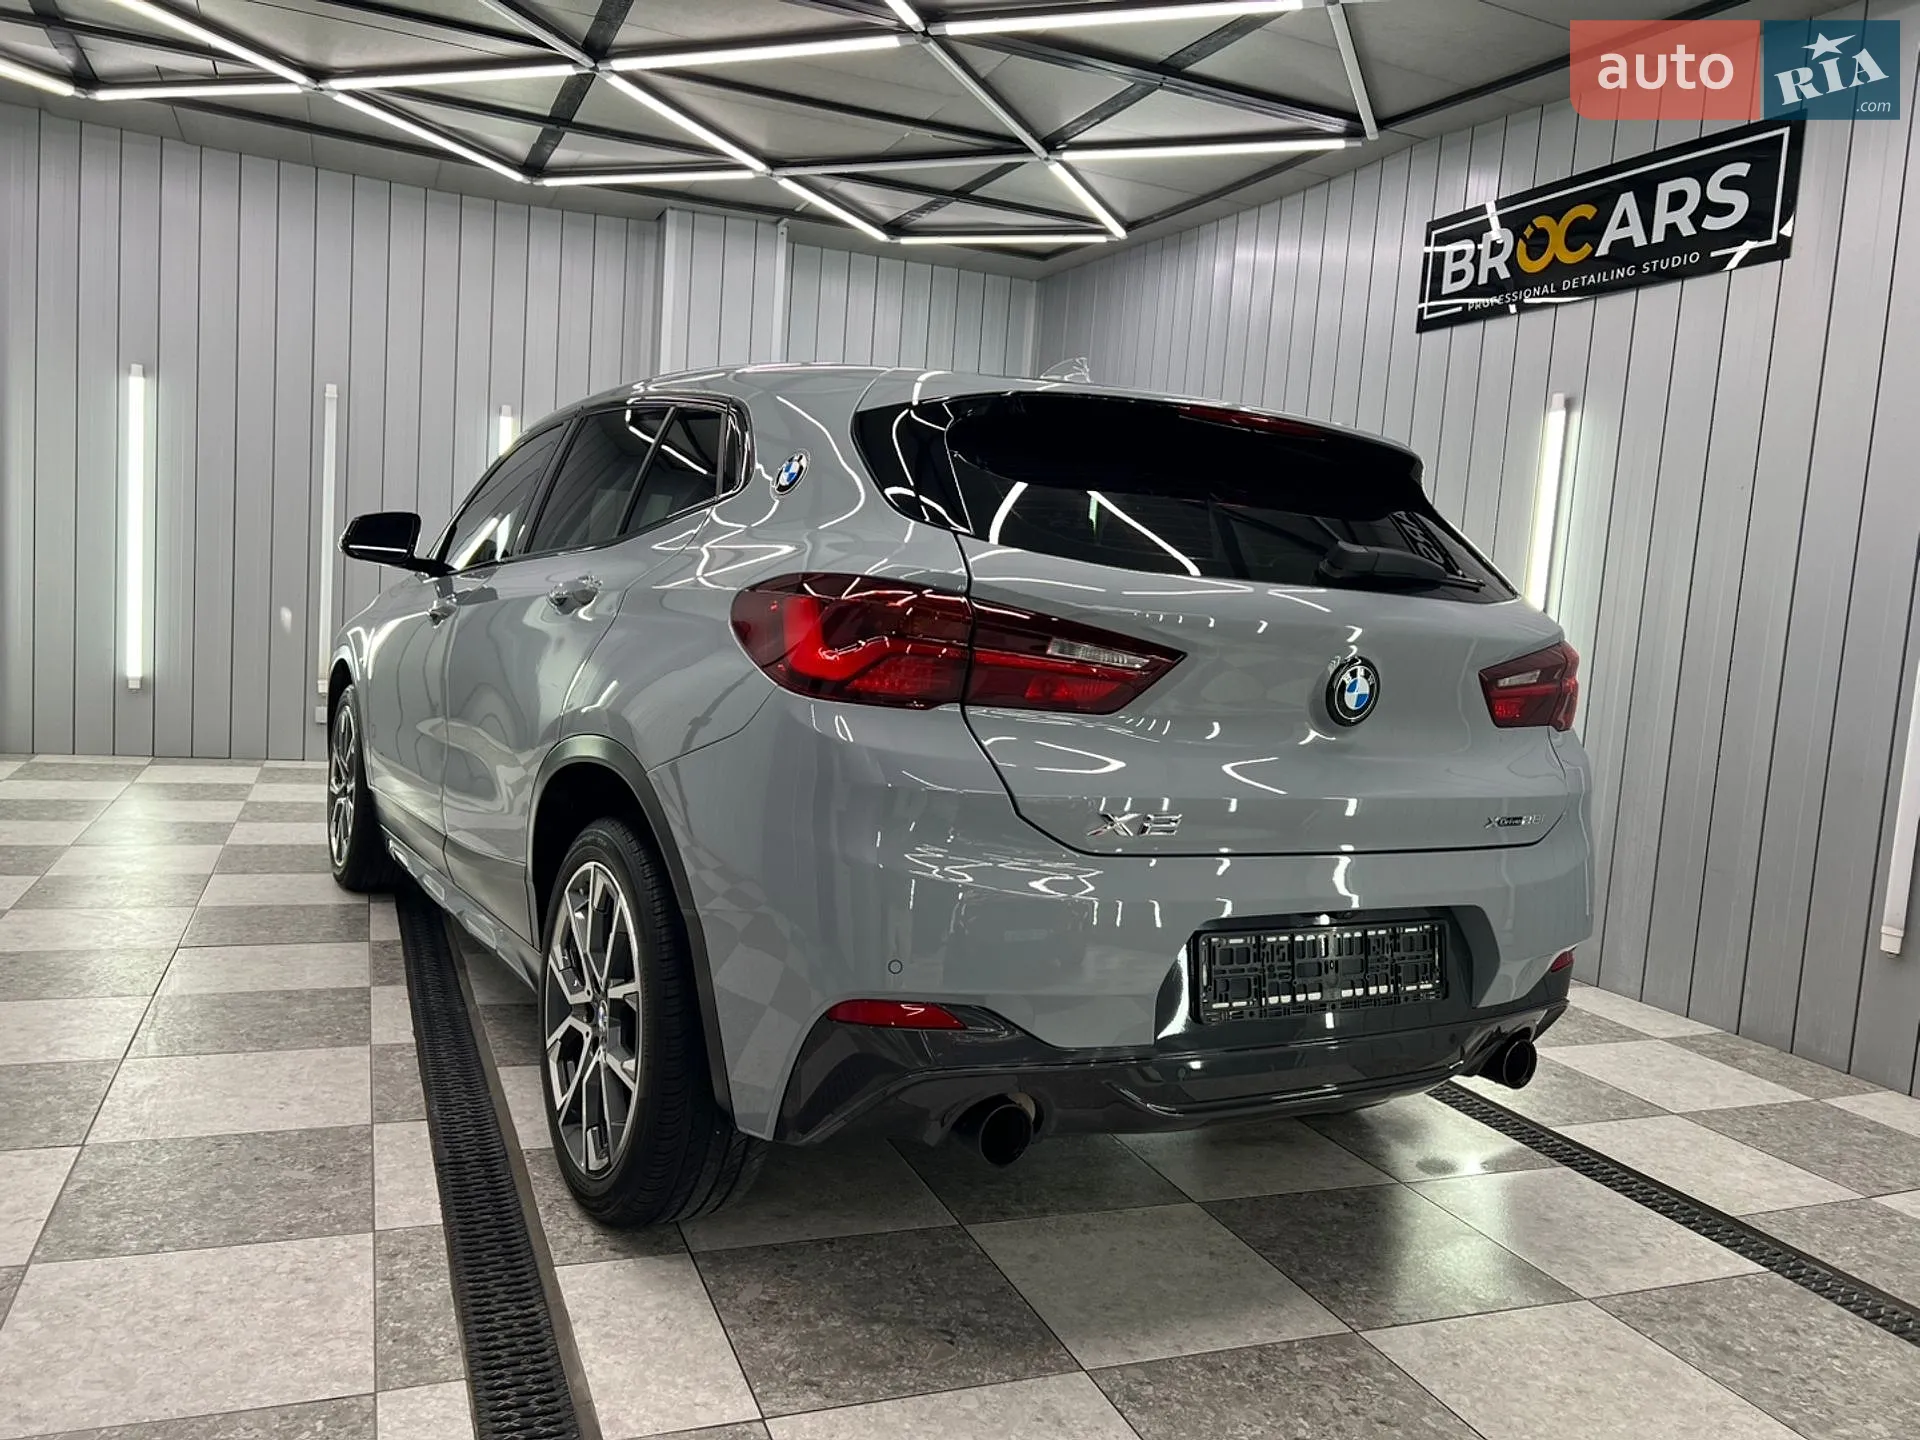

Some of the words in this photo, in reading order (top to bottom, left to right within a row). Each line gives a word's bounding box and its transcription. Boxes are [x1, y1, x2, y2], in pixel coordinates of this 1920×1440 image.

[1441, 161, 1751, 295] BROCARS
[1468, 283, 1556, 312] PROFESSIONAL
[1562, 265, 1636, 291] DETAILING
[1642, 252, 1700, 274] STUDIO
